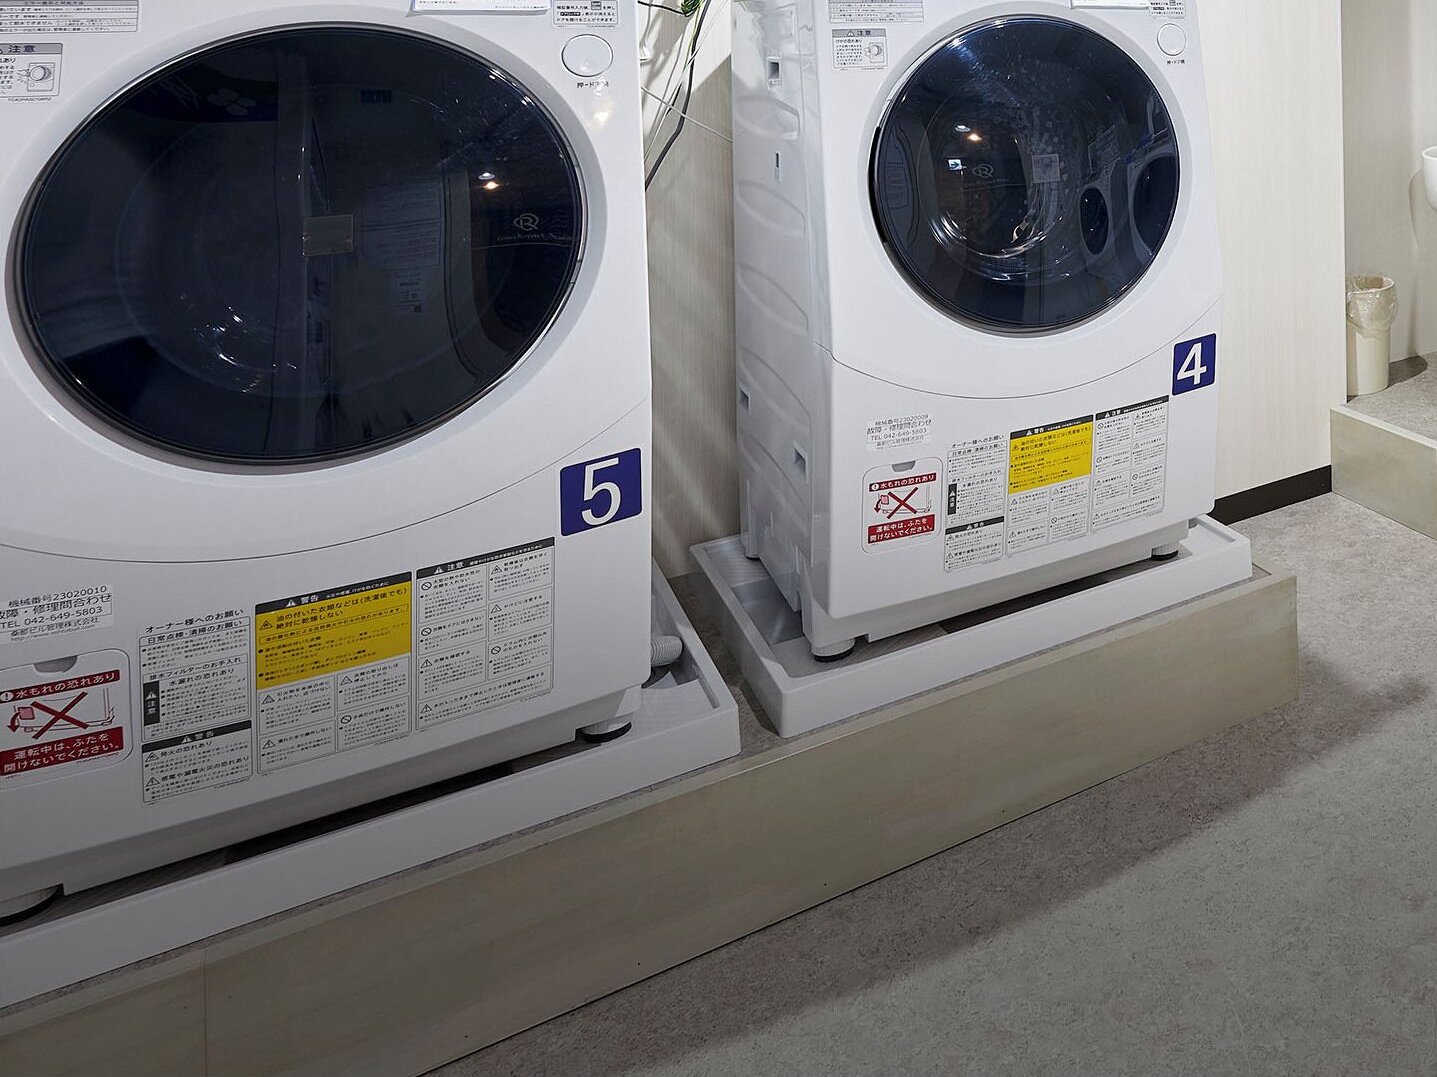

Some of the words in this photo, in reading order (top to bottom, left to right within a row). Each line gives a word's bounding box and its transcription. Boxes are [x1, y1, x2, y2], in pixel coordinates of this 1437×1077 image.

[8, 45, 36, 53] 注意
[1176, 342, 1207, 385] 4
[581, 457, 621, 527] 5
[880, 474, 935, 489] 水もれの恐れあり
[0, 619, 21, 630] TEL
[24, 606, 103, 626] 042-649-5803
[145, 608, 244, 634] オーナー様へのお願い
[15, 671, 115, 699] 水もれの恐れあり
[3, 741, 119, 772] 開けないでください。
[14, 733, 109, 760] 運転中は、ふたを
